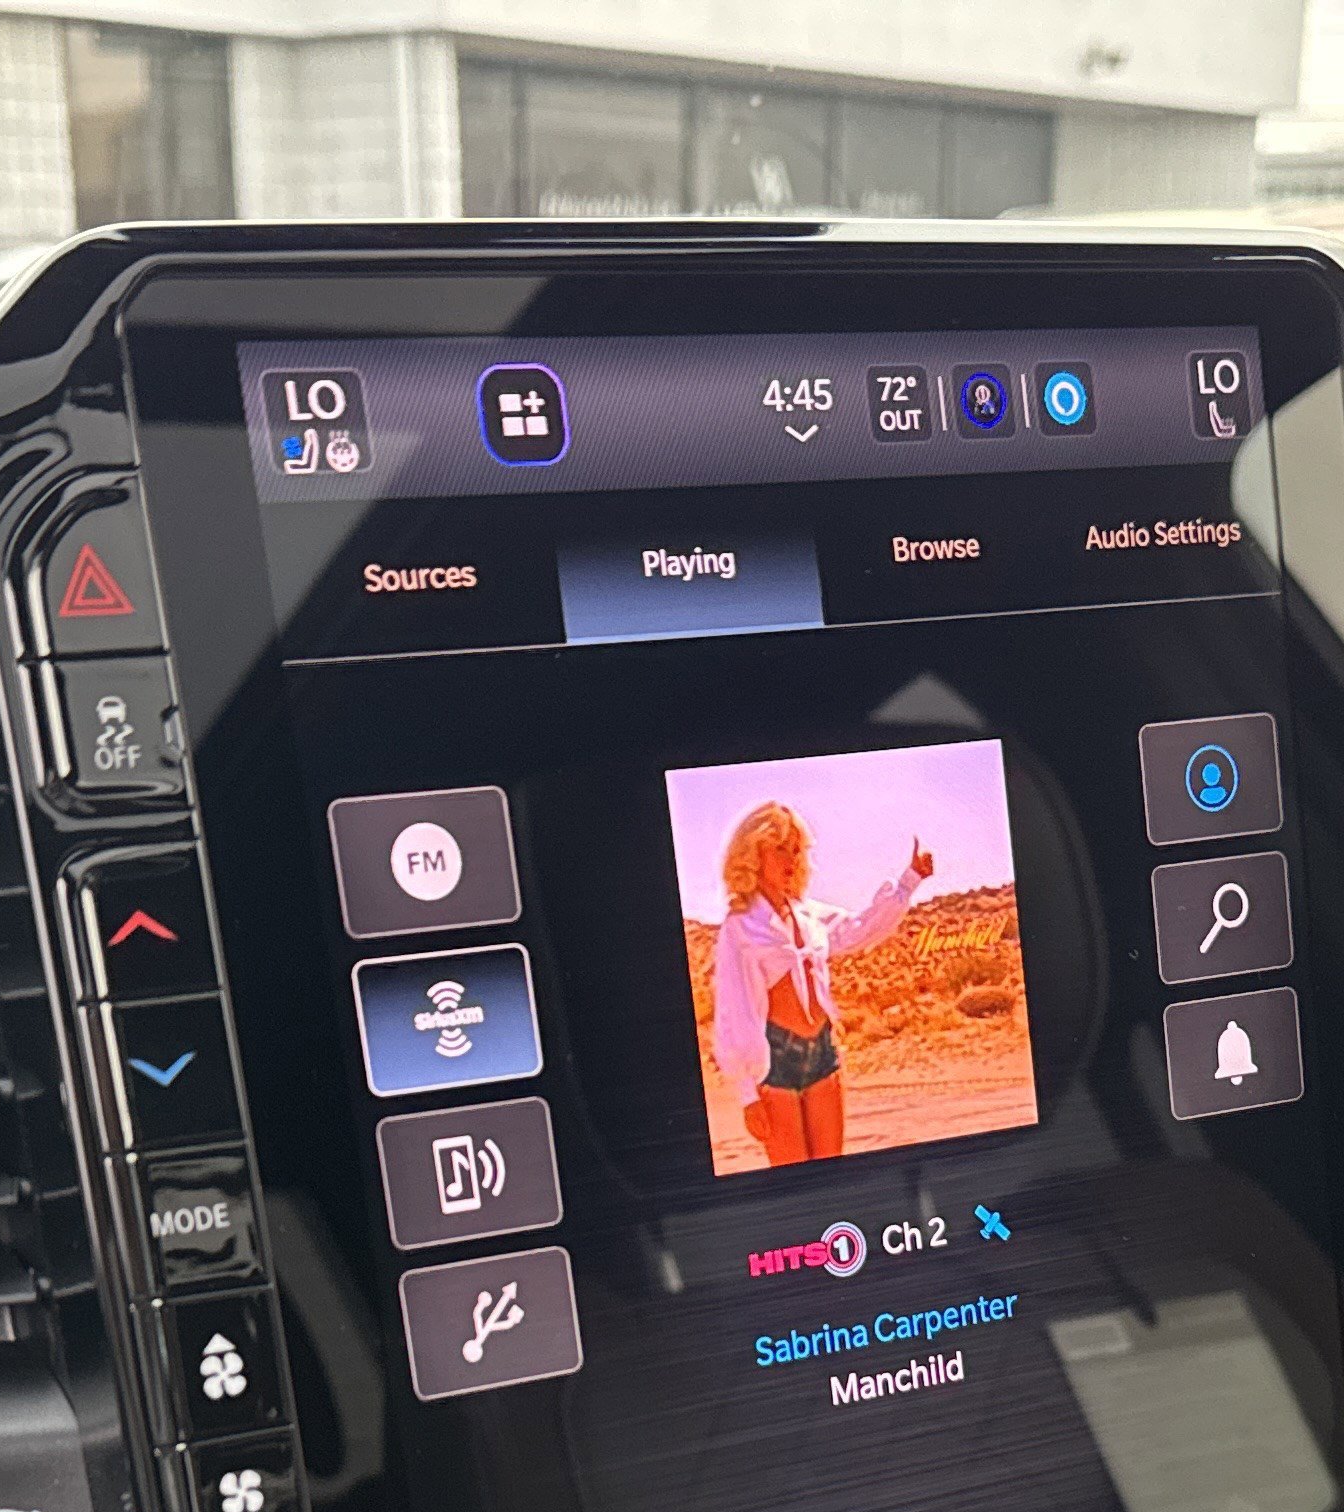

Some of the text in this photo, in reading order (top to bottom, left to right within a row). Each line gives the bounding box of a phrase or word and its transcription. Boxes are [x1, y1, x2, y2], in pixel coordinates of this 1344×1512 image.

[877, 376, 916, 401] 72°
[1197, 359, 1239, 395] LO
[285, 380, 347, 421] LO
[763, 377, 833, 415] 4:45
[879, 409, 922, 431] OUT
[892, 533, 979, 563] Browse
[1084, 517, 1241, 552] Audio Settings
[364, 560, 477, 595] Sources
[643, 546, 737, 580] Playing
[94, 745, 142, 770] OFF
[407, 850, 446, 875] FM
[150, 1202, 231, 1238] MODE
[882, 1217, 948, 1255] Ch 2
[755, 1294, 1019, 1367] Sabrina Carpenter
[829, 1350, 964, 1406] Manchild
